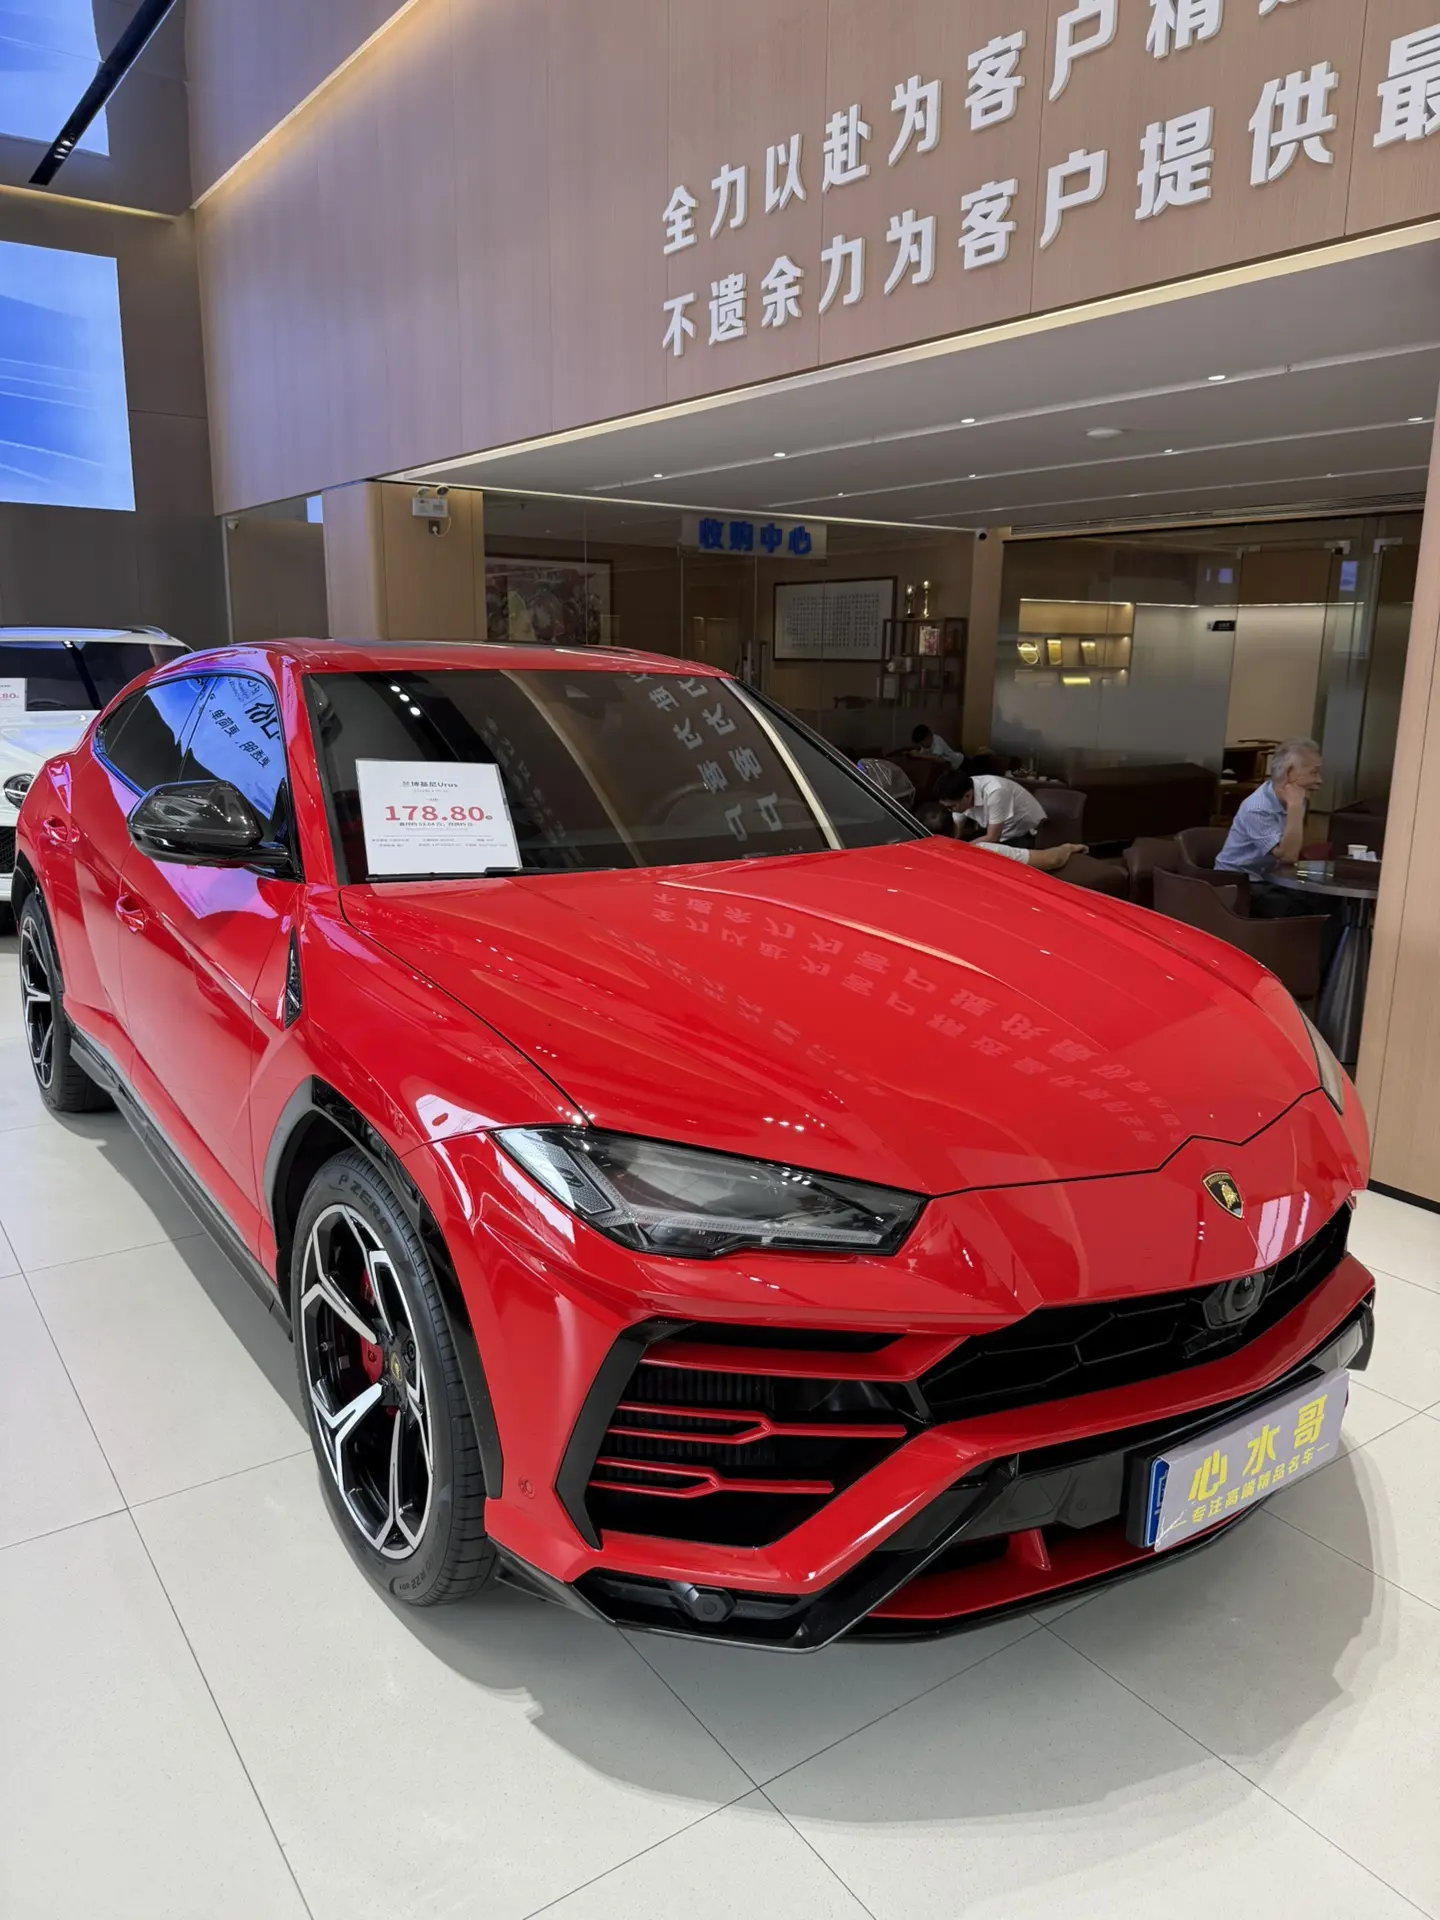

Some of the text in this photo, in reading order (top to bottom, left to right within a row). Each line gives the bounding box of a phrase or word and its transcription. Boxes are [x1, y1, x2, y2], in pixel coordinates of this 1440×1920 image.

[699, 517, 813, 555] 收购中心
[385, 805, 485, 821] 178.80
[350, 1180, 393, 1235] ZERO
[1187, 1394, 1328, 1501] 心水哥
[1191, 1448, 1315, 1523] 专注高端精品名车
